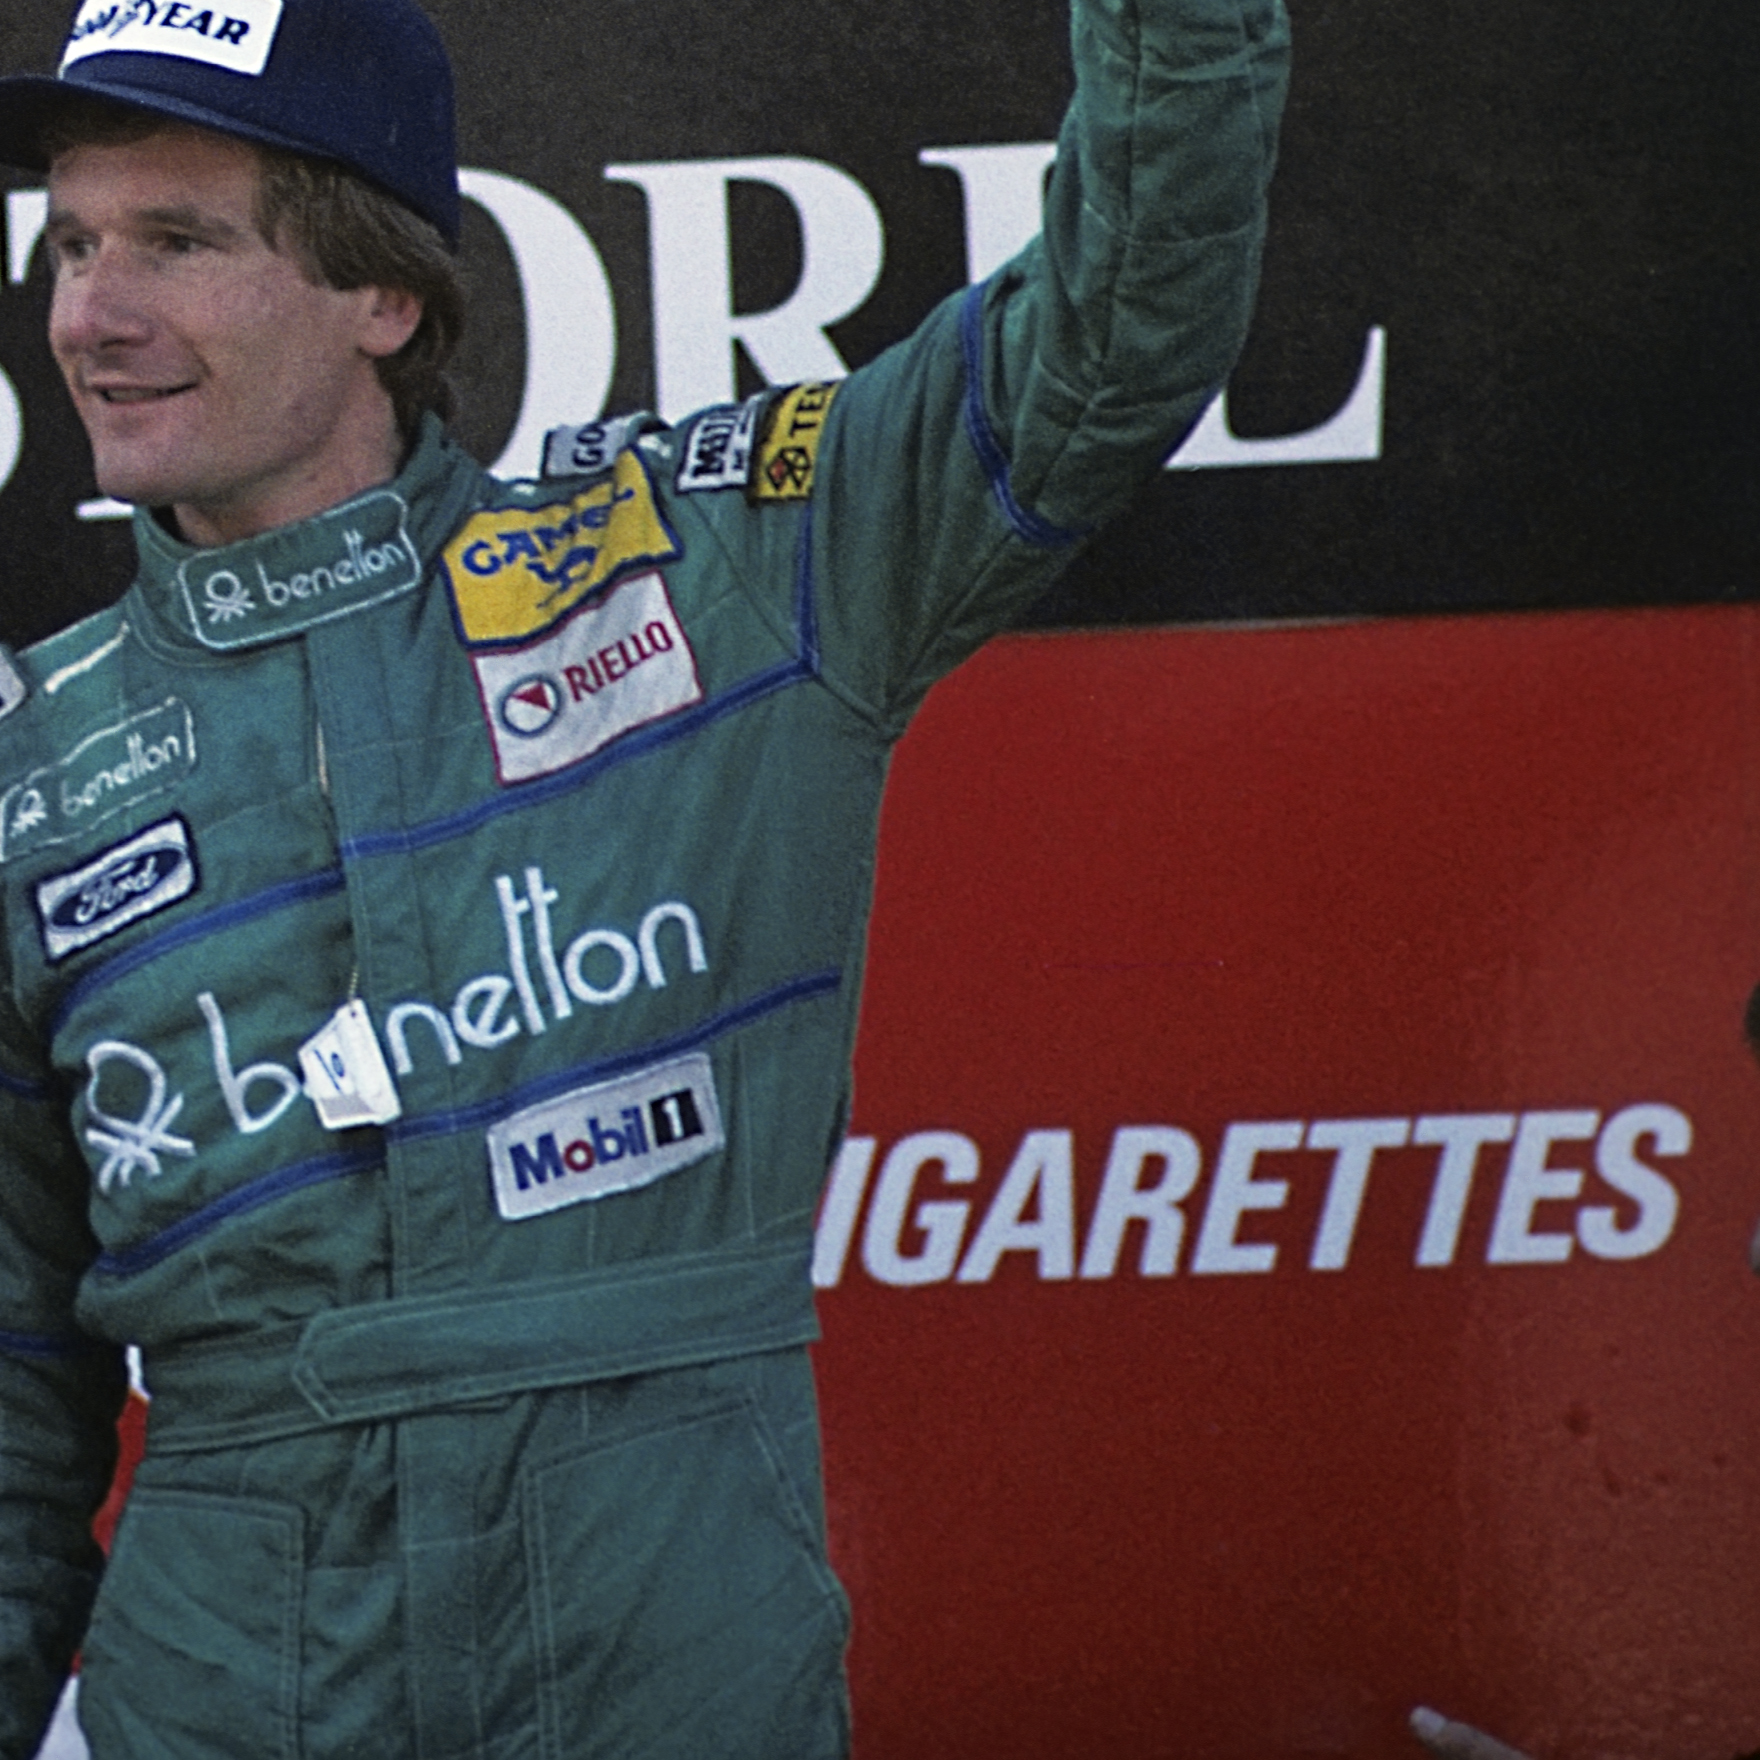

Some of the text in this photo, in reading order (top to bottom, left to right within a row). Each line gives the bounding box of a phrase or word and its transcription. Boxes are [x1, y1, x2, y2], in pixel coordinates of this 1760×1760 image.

[562, 619, 674, 705] RIELLO
[76, 863, 162, 924] Ford
[197, 866, 707, 1134] bnetton
[508, 1106, 649, 1193] Mobil
